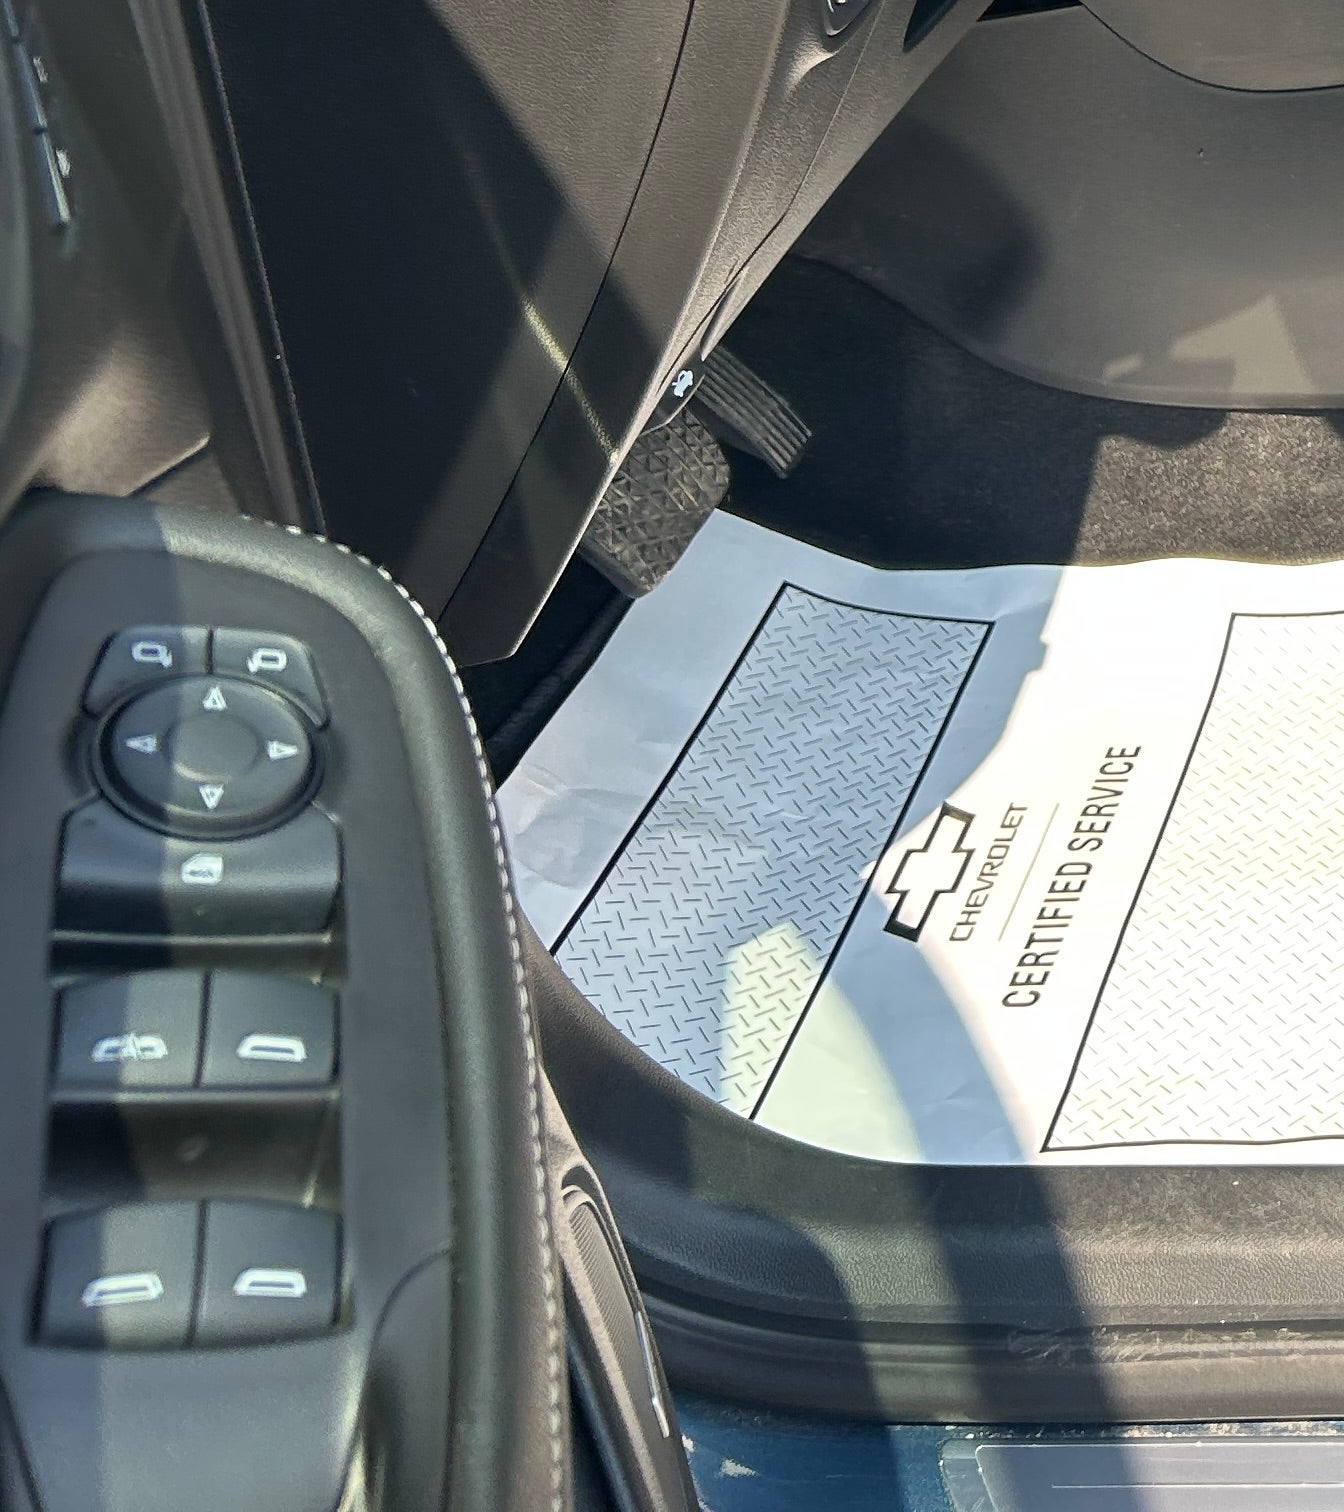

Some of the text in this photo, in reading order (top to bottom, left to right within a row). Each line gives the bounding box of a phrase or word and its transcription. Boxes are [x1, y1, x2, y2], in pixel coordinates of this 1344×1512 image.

[949, 802, 1028, 941] CHEVROLET
[1001, 746, 1142, 1008] CERTIFIED SERVICE
